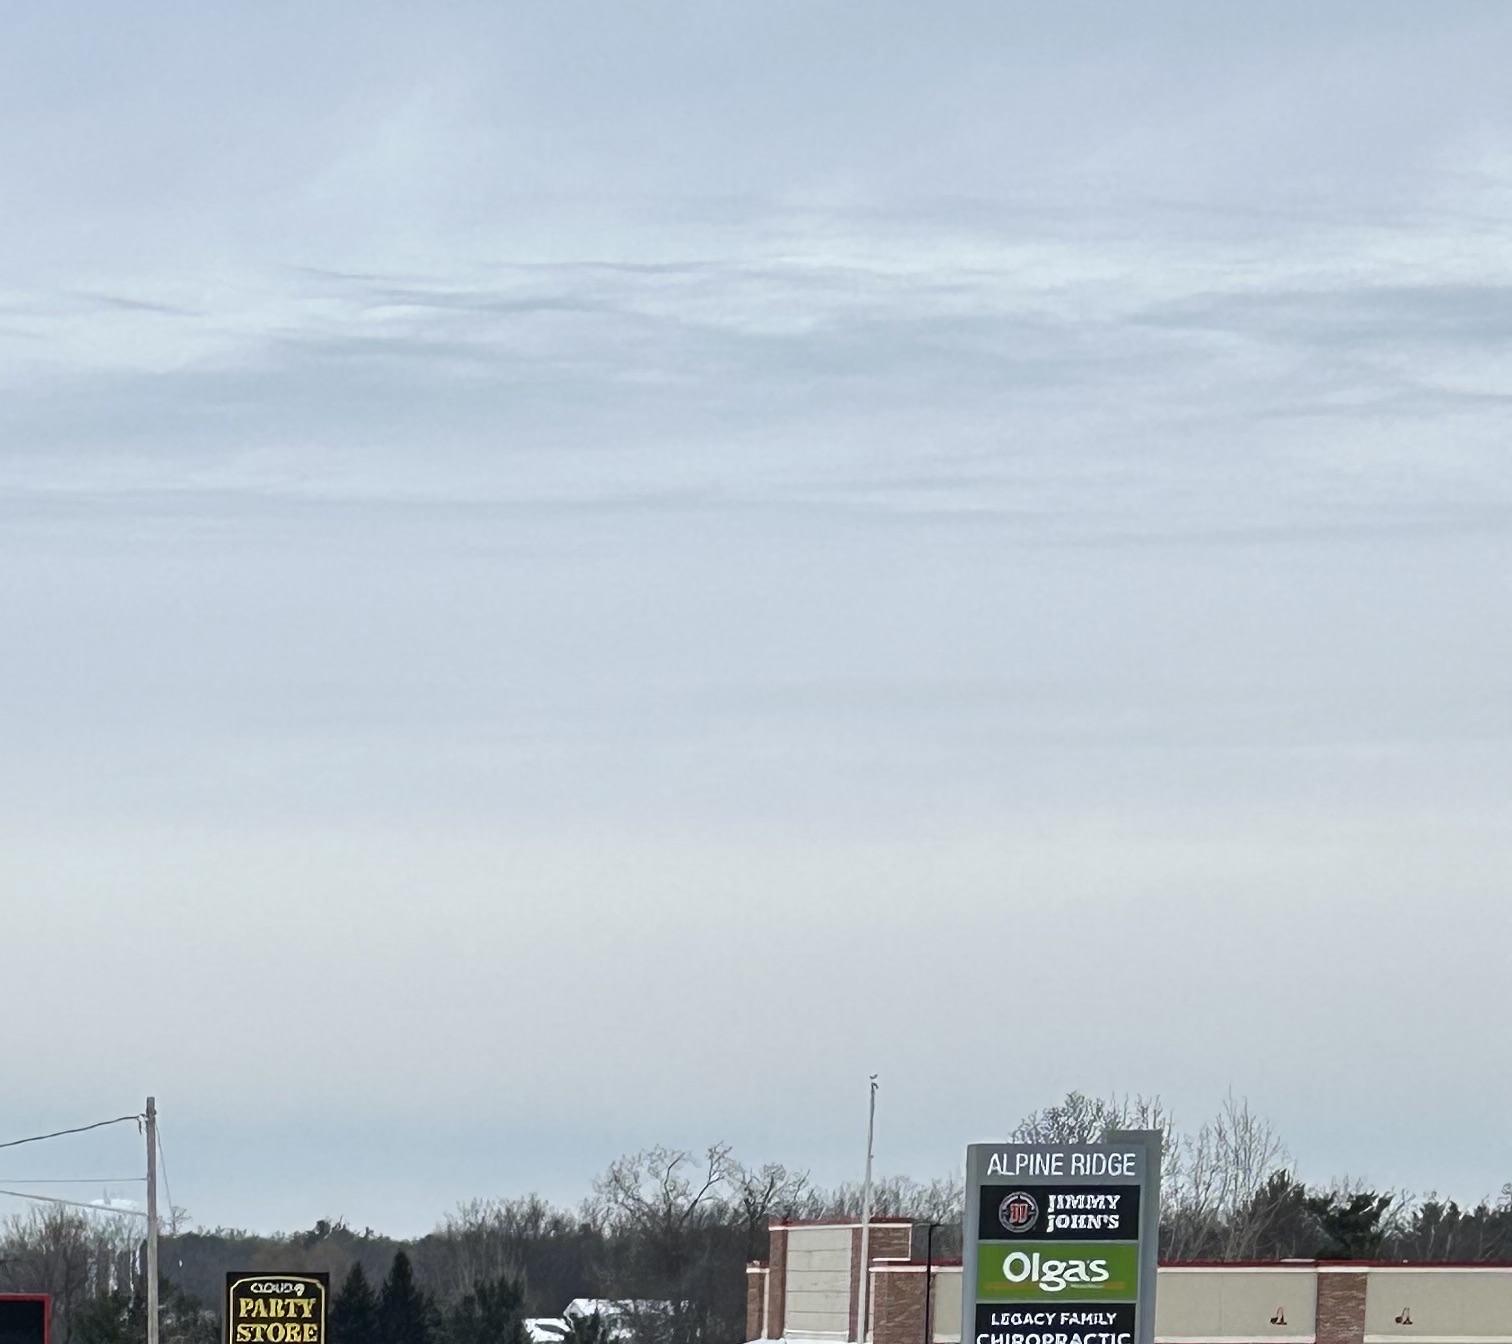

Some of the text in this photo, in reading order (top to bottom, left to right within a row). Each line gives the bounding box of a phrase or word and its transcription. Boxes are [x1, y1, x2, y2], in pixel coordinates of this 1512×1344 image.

[987, 1153, 1136, 1176] ALPINE RIDGE
[1048, 1194, 1121, 1213] JIMMY
[1045, 1214, 1120, 1233] JOHN'S
[239, 1298, 317, 1318] PARTY
[991, 1313, 1118, 1326] LEGACY FAMILY
[236, 1322, 318, 1343] STORE
